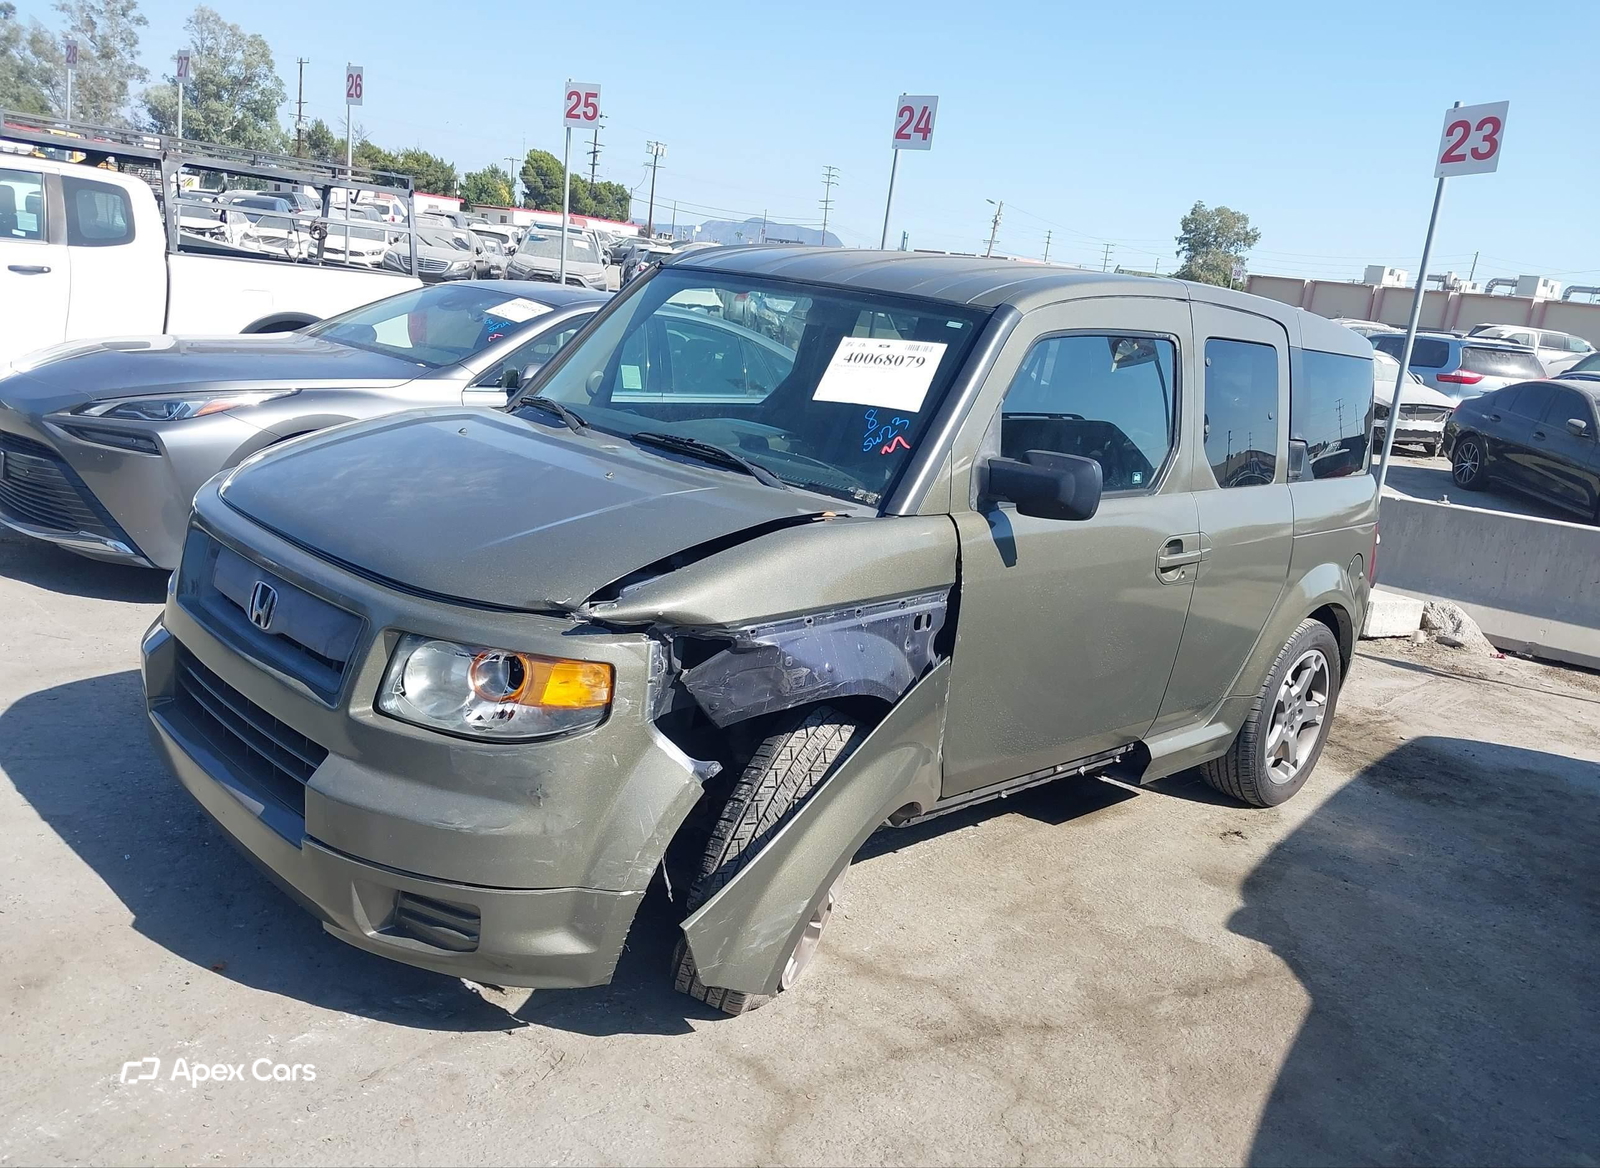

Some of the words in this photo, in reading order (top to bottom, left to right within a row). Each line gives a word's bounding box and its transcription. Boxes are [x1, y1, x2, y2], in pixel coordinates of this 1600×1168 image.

[66, 45, 78, 64] 28
[177, 56, 190, 77] 27
[347, 73, 362, 98] 26
[566, 90, 598, 121] 25
[895, 105, 932, 141] 24
[1440, 116, 1501, 164] 23
[843, 351, 926, 369] 40068079
